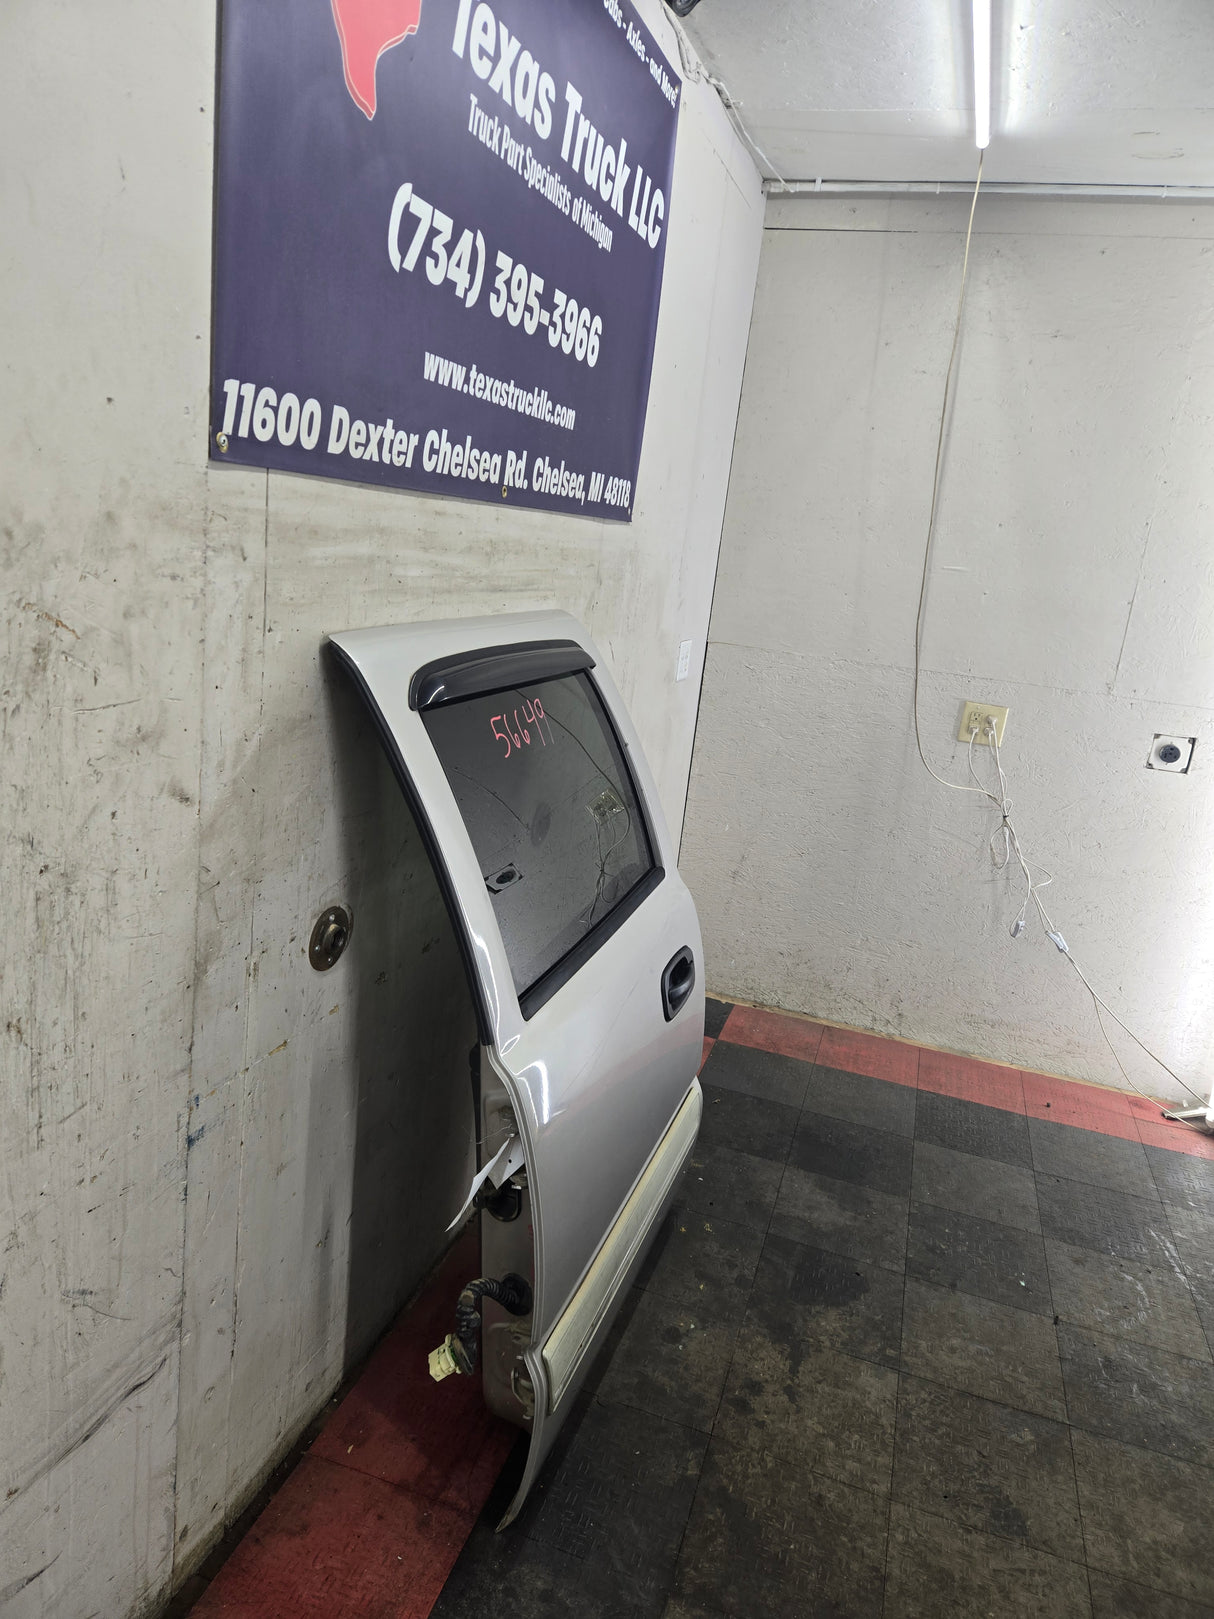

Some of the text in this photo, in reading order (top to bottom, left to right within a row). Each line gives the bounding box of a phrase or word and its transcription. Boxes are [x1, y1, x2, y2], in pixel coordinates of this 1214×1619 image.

[626, 21, 646, 62] Axles
[649, 57, 663, 86] and
[452, 0, 665, 249] Texas Truck LLC
[468, 93, 613, 253] Truck Part Specialists of Michigan
[388, 182, 602, 368] (734) 395-3966
[222, 378, 632, 508] 11600 Dexter Chelsea Rd. Chelsea, MI 48118
[423, 351, 576, 431] www.texastruckllc.com
[489, 697, 555, 758] 56649
